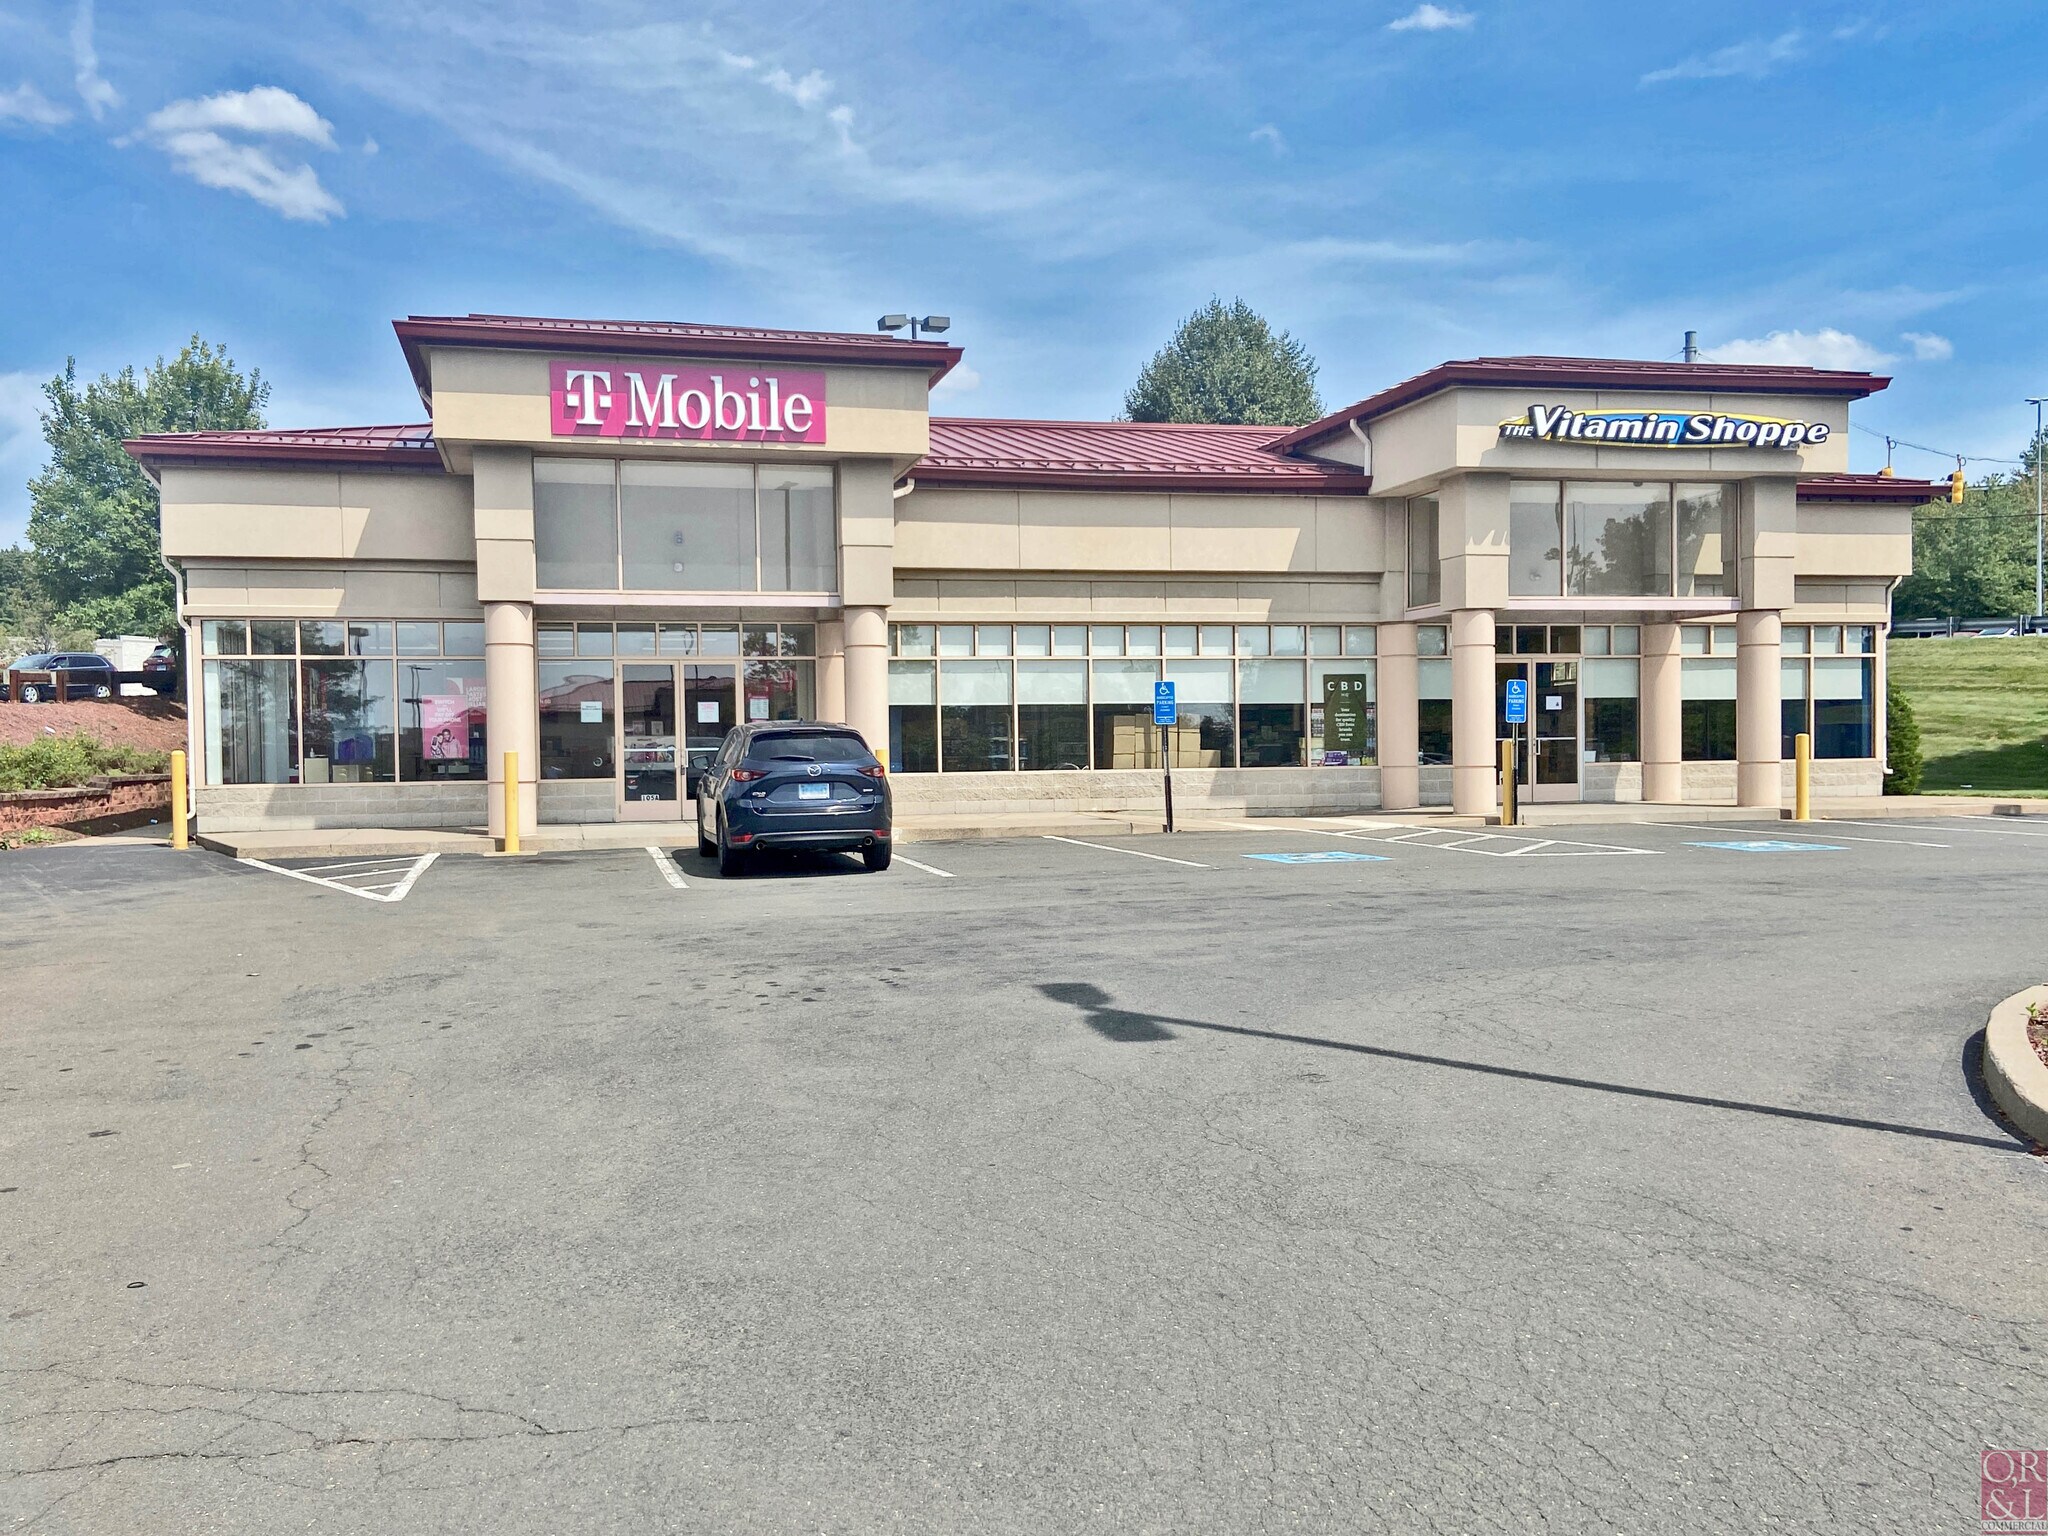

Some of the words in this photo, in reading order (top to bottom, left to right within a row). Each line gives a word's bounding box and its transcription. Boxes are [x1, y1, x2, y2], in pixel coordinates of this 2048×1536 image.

[623, 371, 813, 433] Mobile
[1504, 424, 1534, 438] THE
[1529, 404, 1681, 441] Vitamin
[1684, 414, 1831, 448] Shoppe
